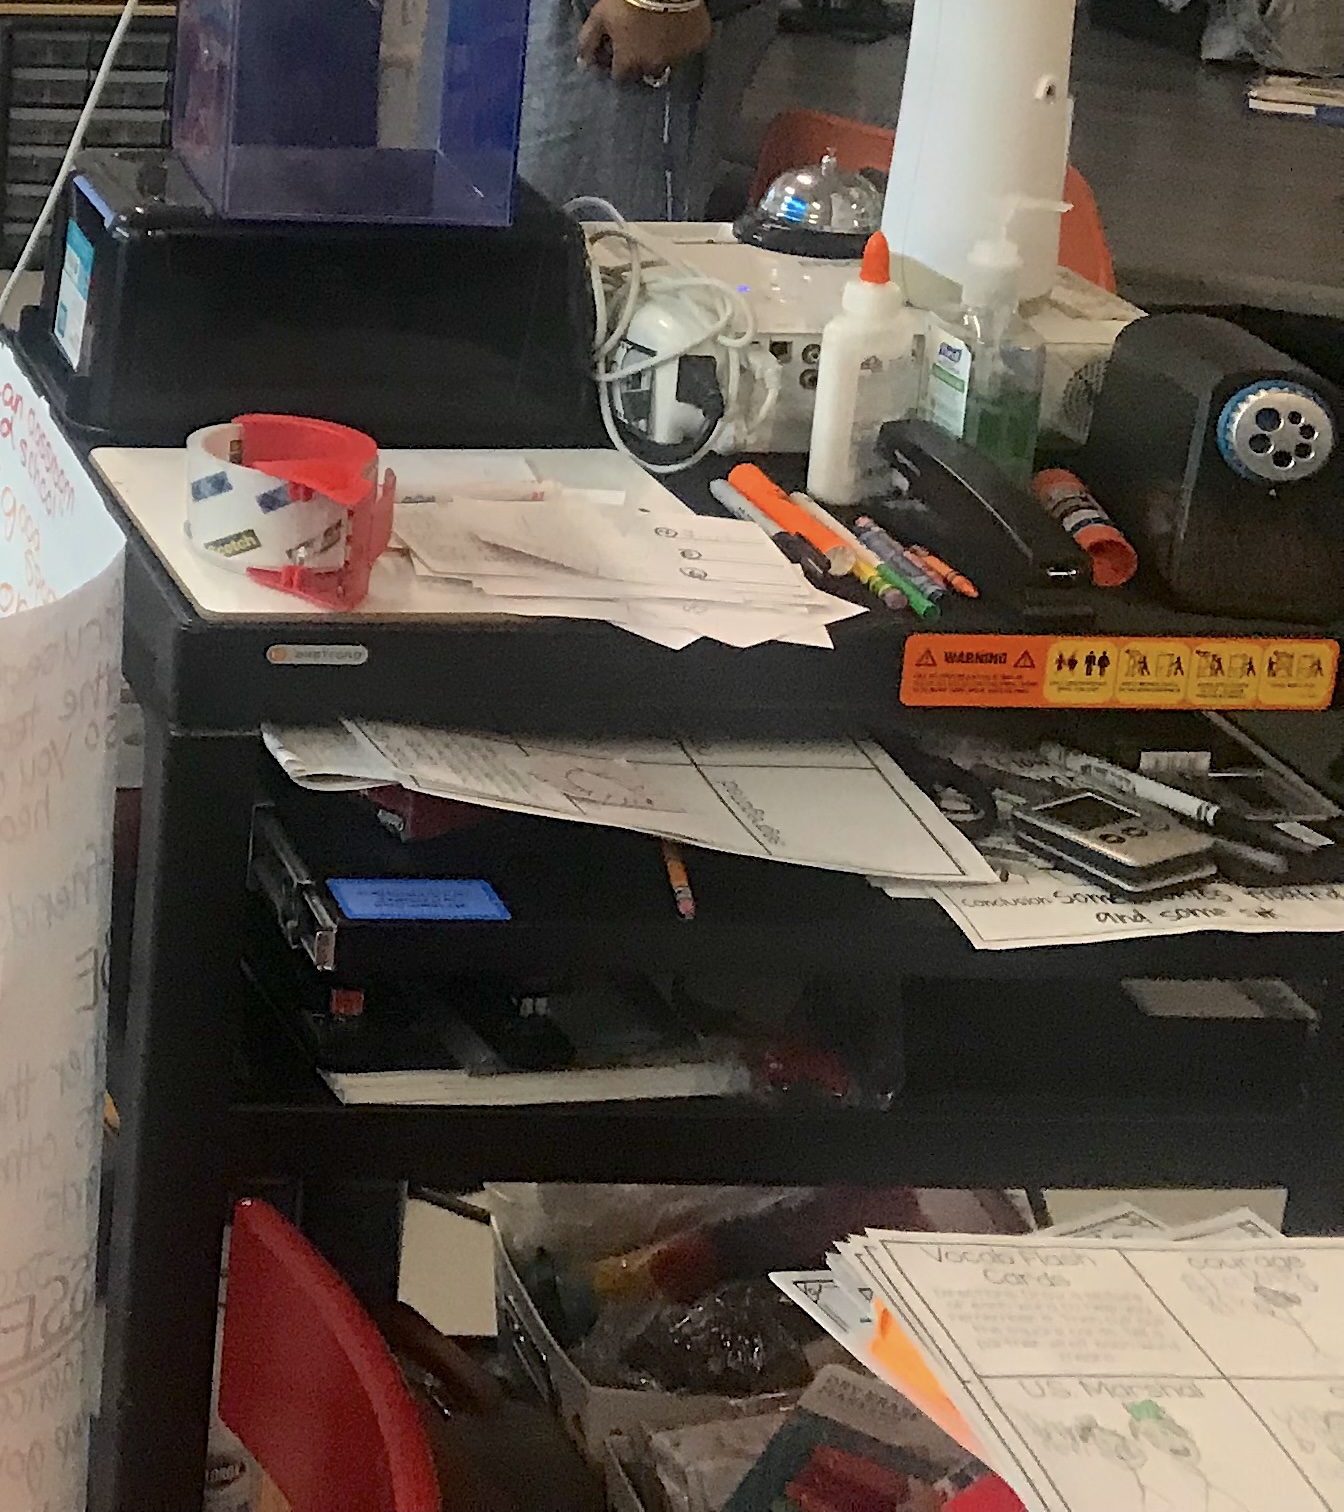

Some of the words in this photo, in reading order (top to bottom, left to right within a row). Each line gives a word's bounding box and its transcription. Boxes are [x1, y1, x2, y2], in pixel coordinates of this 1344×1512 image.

[1096, 910, 1152, 924] and
[920, 1245, 1024, 1267] Vocab
[1025, 1244, 1098, 1266] Flash
[1189, 1252, 1306, 1273] courage
[983, 1267, 1072, 1288] Cards
[1018, 1380, 1072, 1399] US
[1081, 1379, 1205, 1400] Marshal
